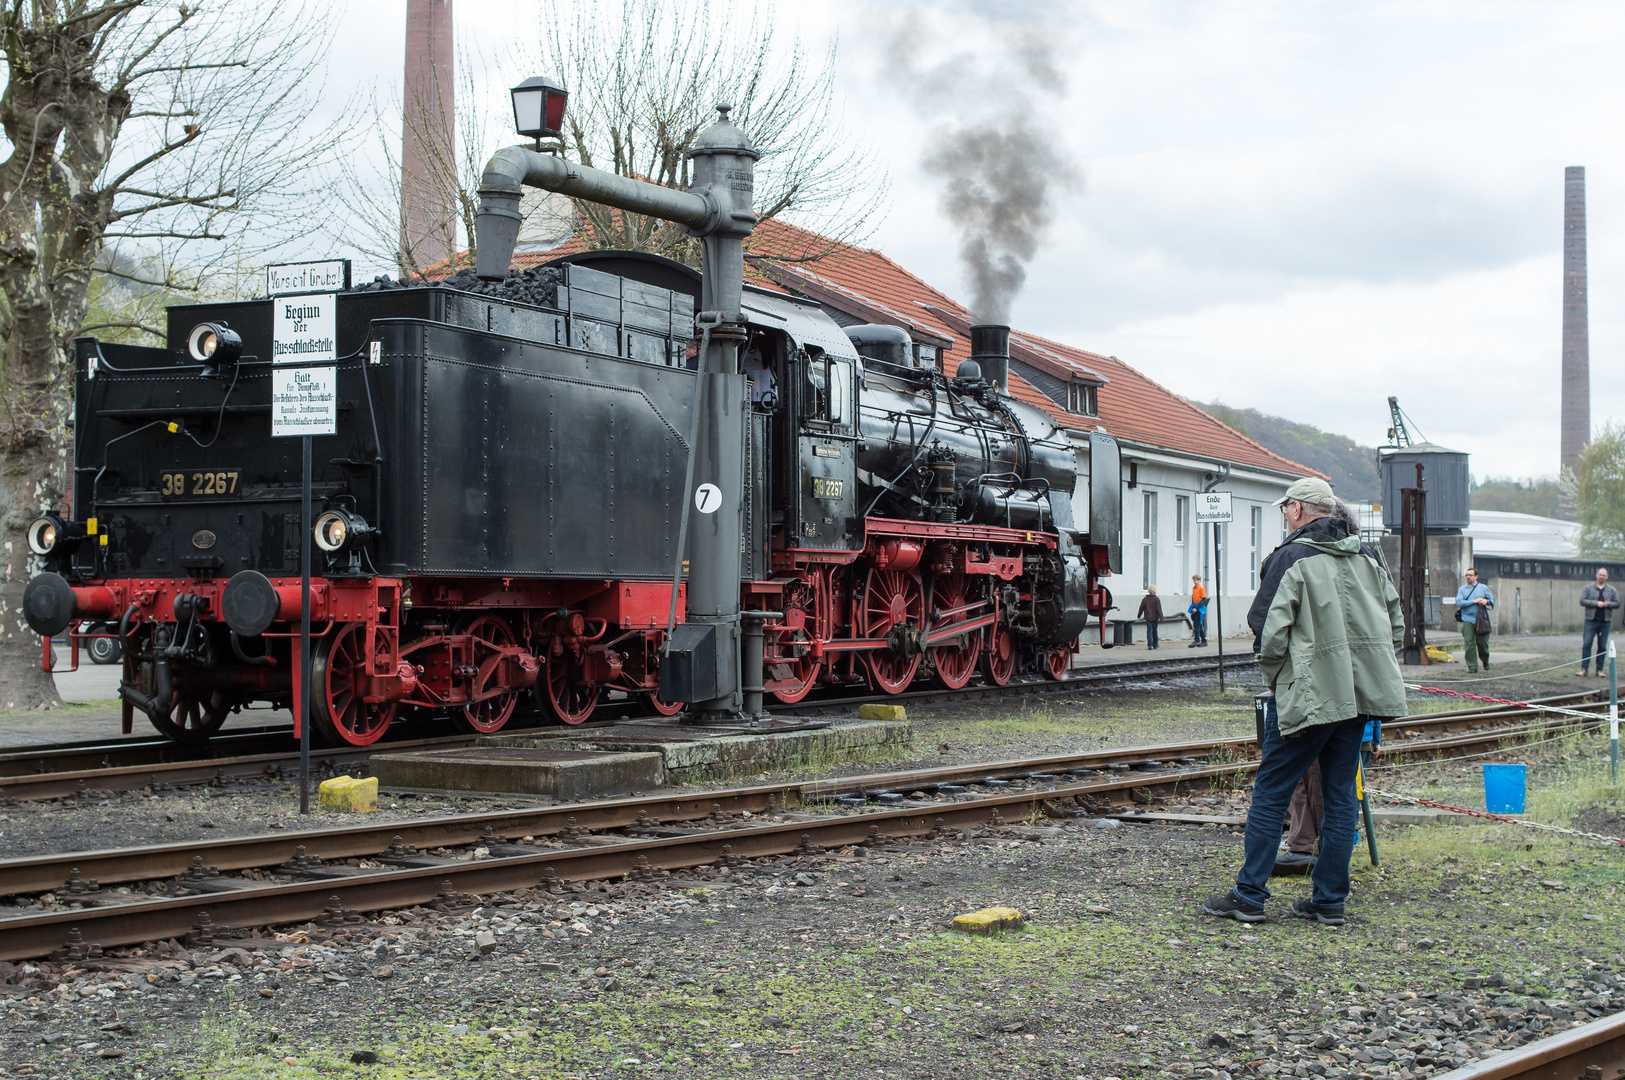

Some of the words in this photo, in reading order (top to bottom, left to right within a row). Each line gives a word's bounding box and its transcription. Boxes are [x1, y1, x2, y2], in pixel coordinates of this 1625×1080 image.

[270, 268, 306, 289] Vorsicht
[310, 266, 341, 286] Grube!
[285, 304, 320, 324] Beginn
[294, 320, 308, 332] der
[274, 338, 334, 357] Ausschlackstelle
[294, 370, 311, 382] Halt
[162, 474, 184, 496] 38
[192, 472, 238, 494] 2267
[814, 478, 824, 496] 38
[826, 480, 843, 496] 2267
[700, 489, 710, 510] 7
